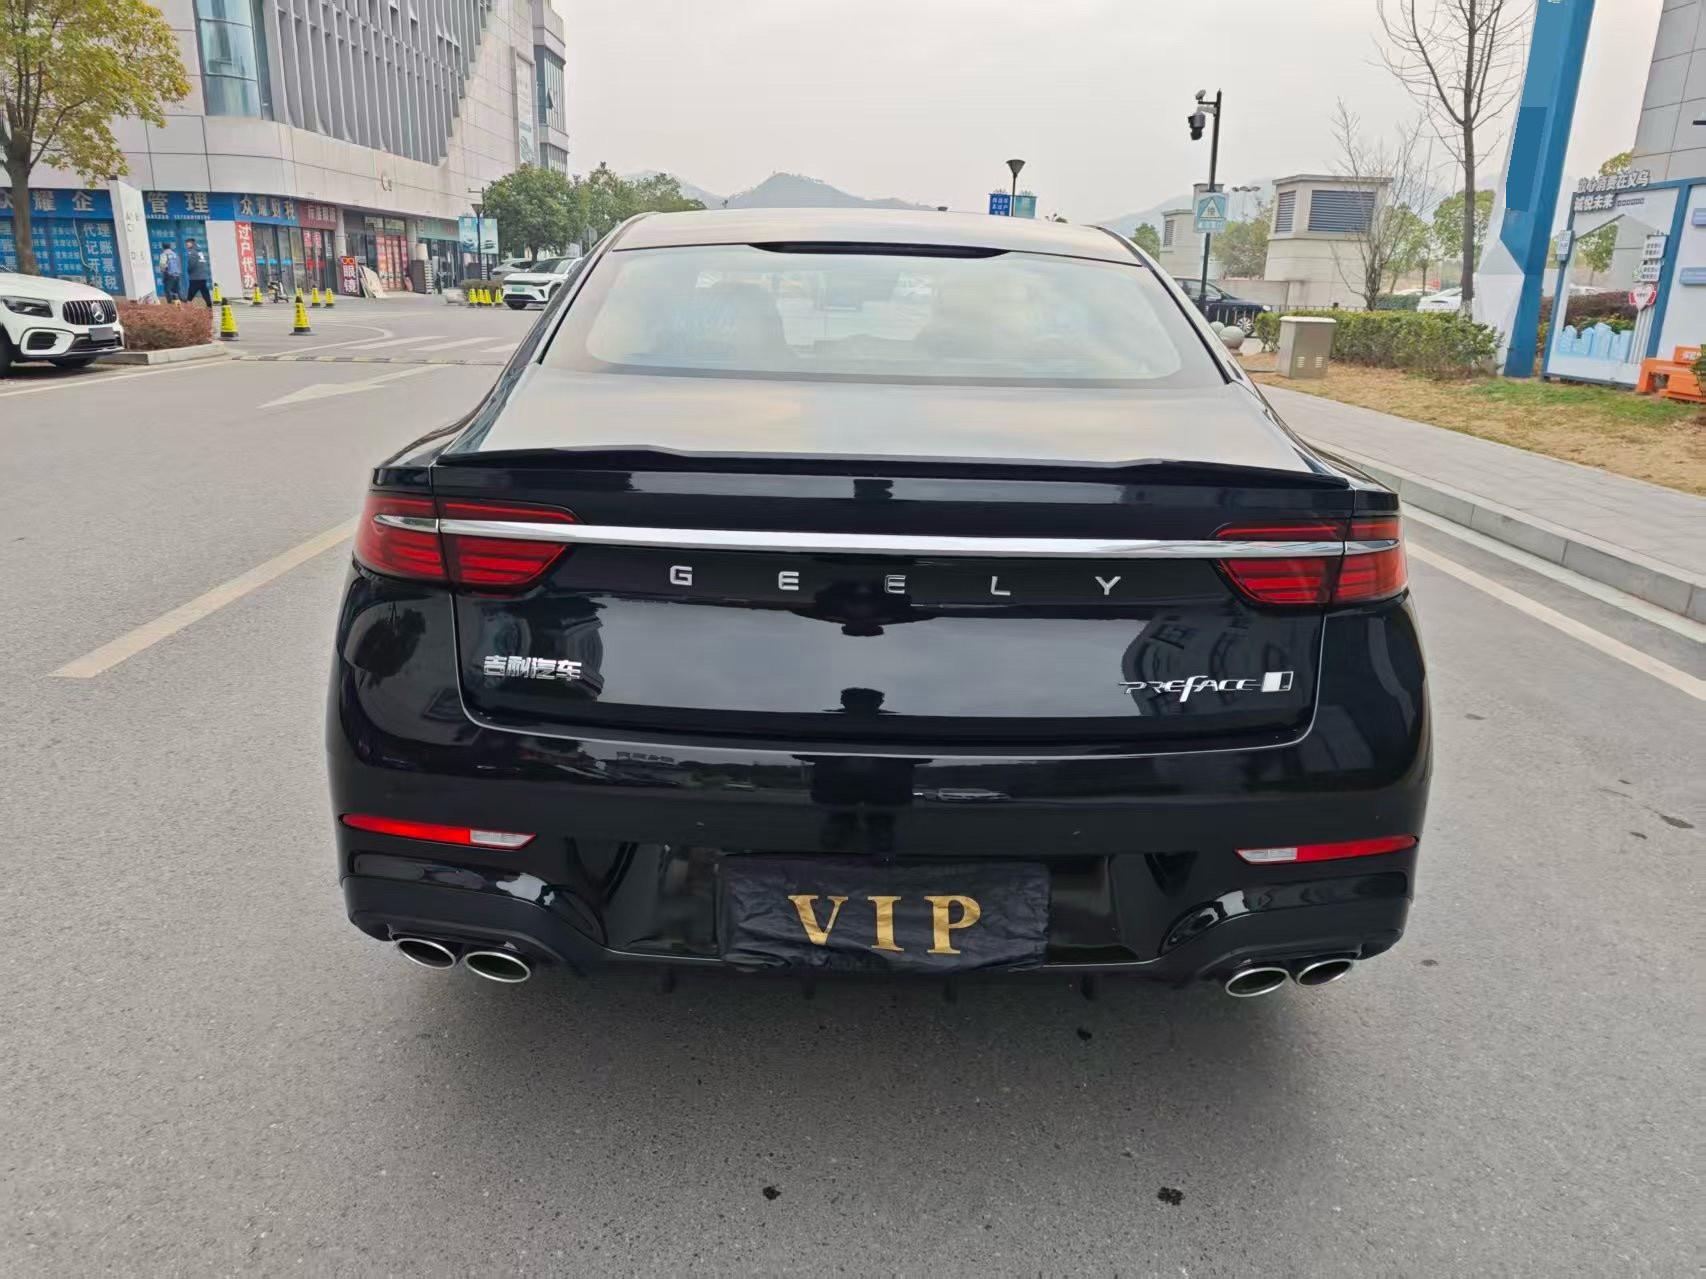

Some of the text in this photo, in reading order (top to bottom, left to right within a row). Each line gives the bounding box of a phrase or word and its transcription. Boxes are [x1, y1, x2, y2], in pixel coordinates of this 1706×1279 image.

[669, 564, 1122, 597] GEELY
[483, 655, 582, 681] 吉利汽车
[787, 895, 982, 955] VIP
